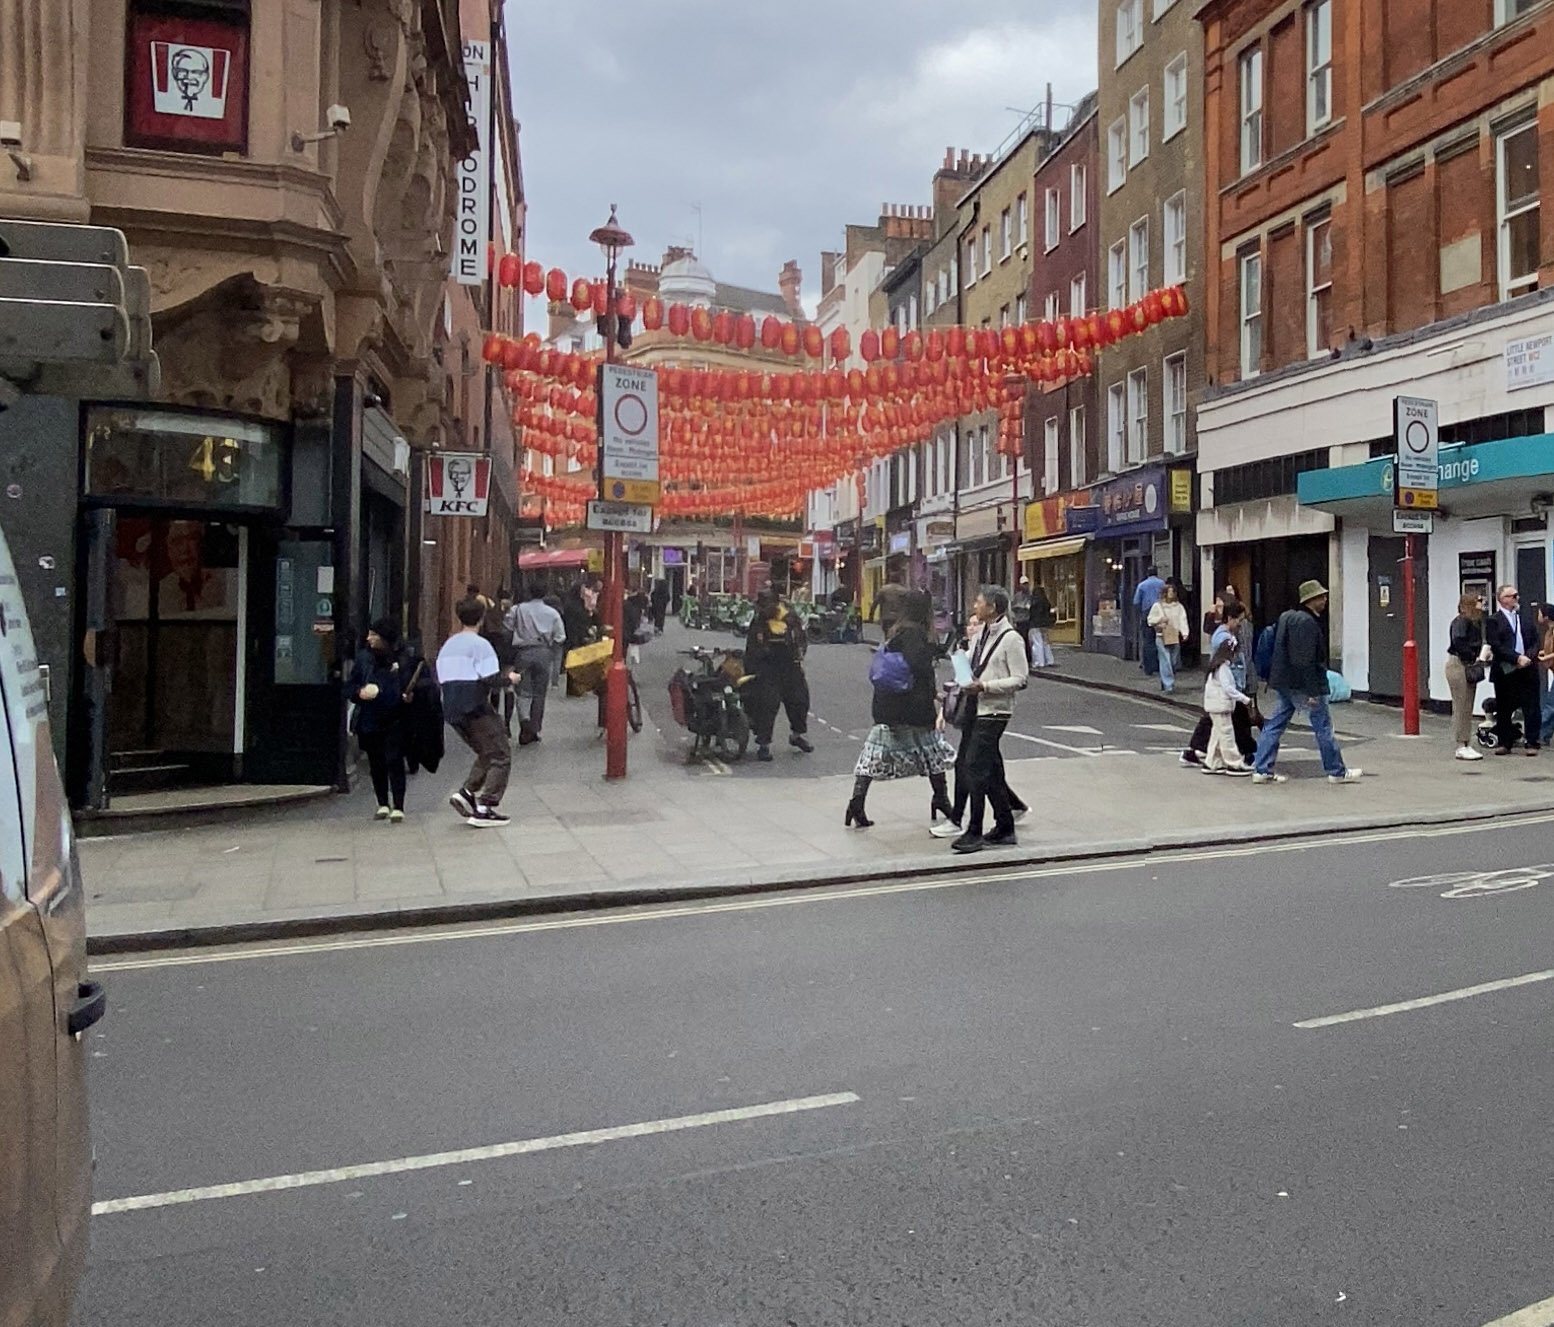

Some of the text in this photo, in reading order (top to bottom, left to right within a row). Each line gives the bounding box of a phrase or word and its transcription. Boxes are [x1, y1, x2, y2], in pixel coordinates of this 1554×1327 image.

[1506, 335, 1553, 356] LITTLE NEWPORT
[1506, 354, 1527, 367] STREET
[615, 377, 647, 392] ZONE
[1405, 407, 1429, 418] ZONE
[440, 500, 480, 513] KFC
